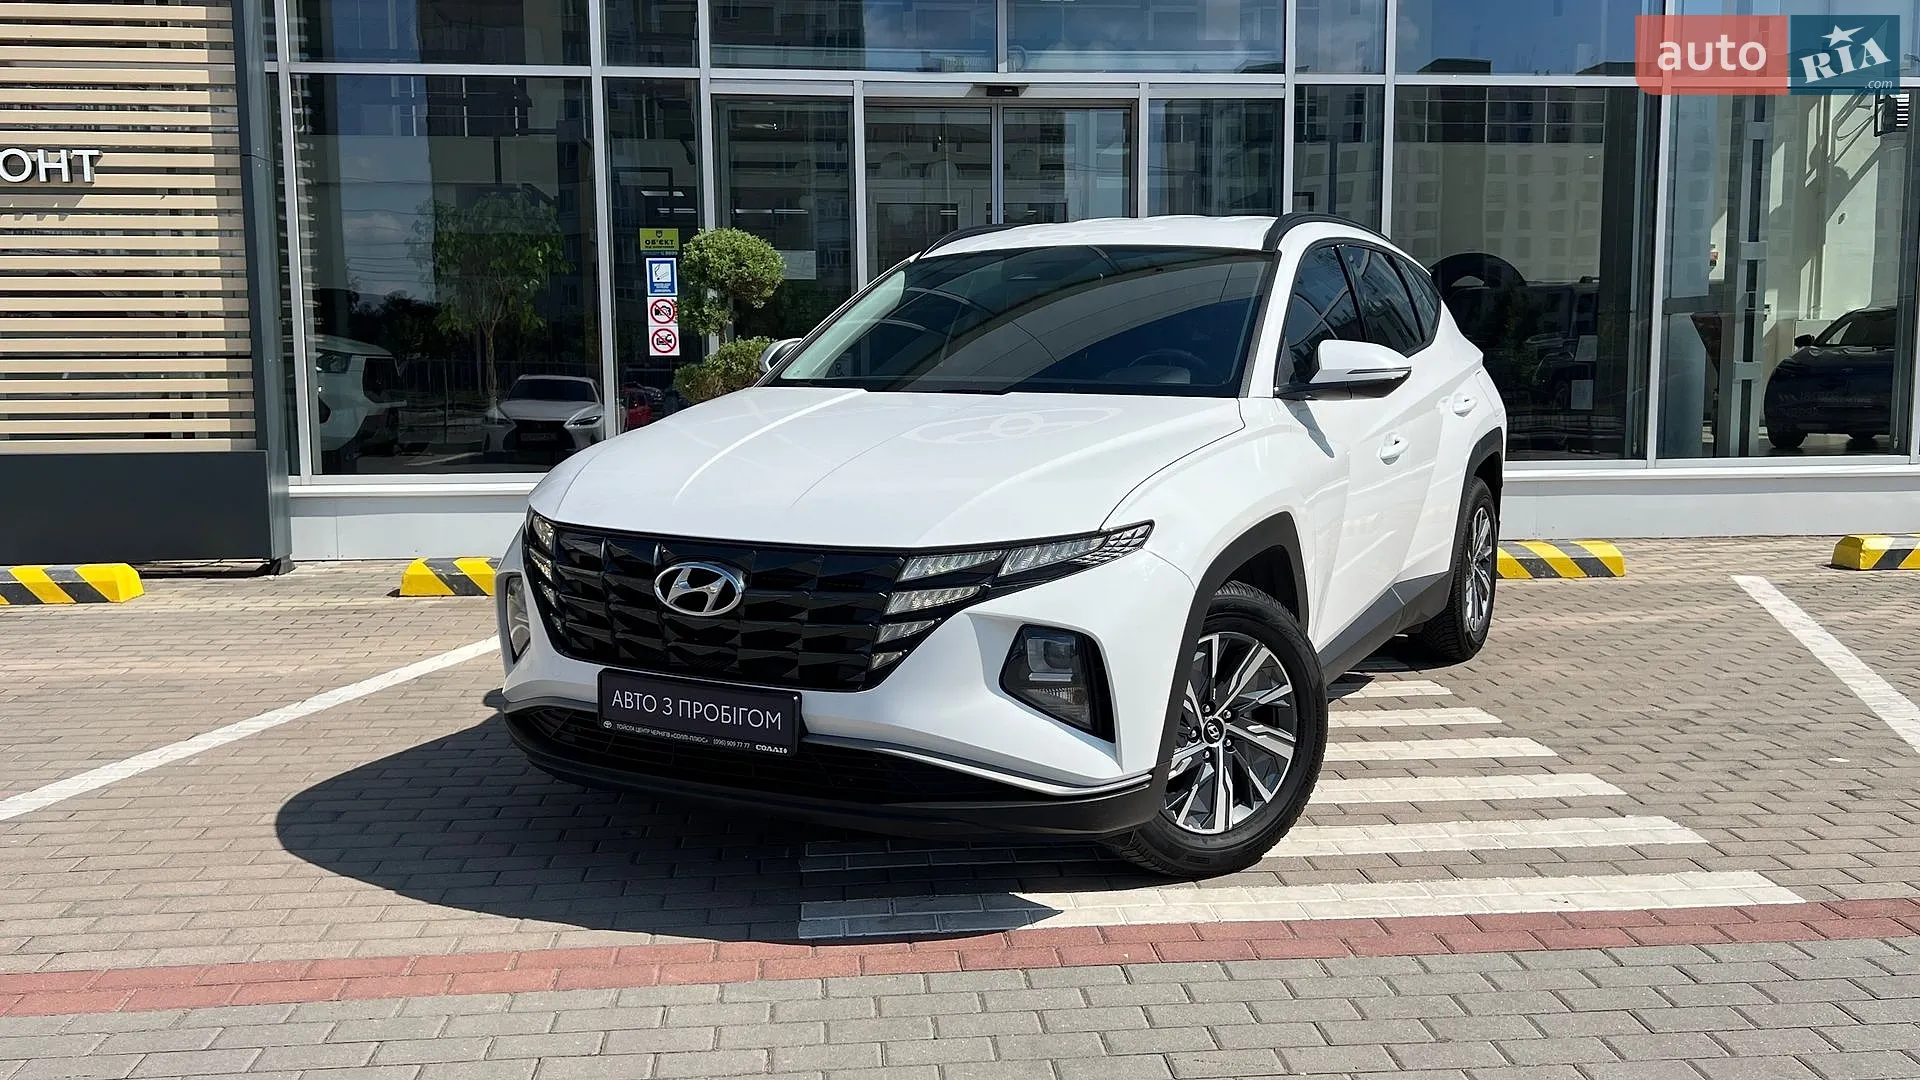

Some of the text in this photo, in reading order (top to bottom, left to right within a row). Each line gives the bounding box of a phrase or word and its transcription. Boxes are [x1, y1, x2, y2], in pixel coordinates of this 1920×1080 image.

[0, 147, 100, 183] ОНТ
[612, 690, 657, 713] АВТО
[679, 699, 782, 731] ПРОБІГОМ
